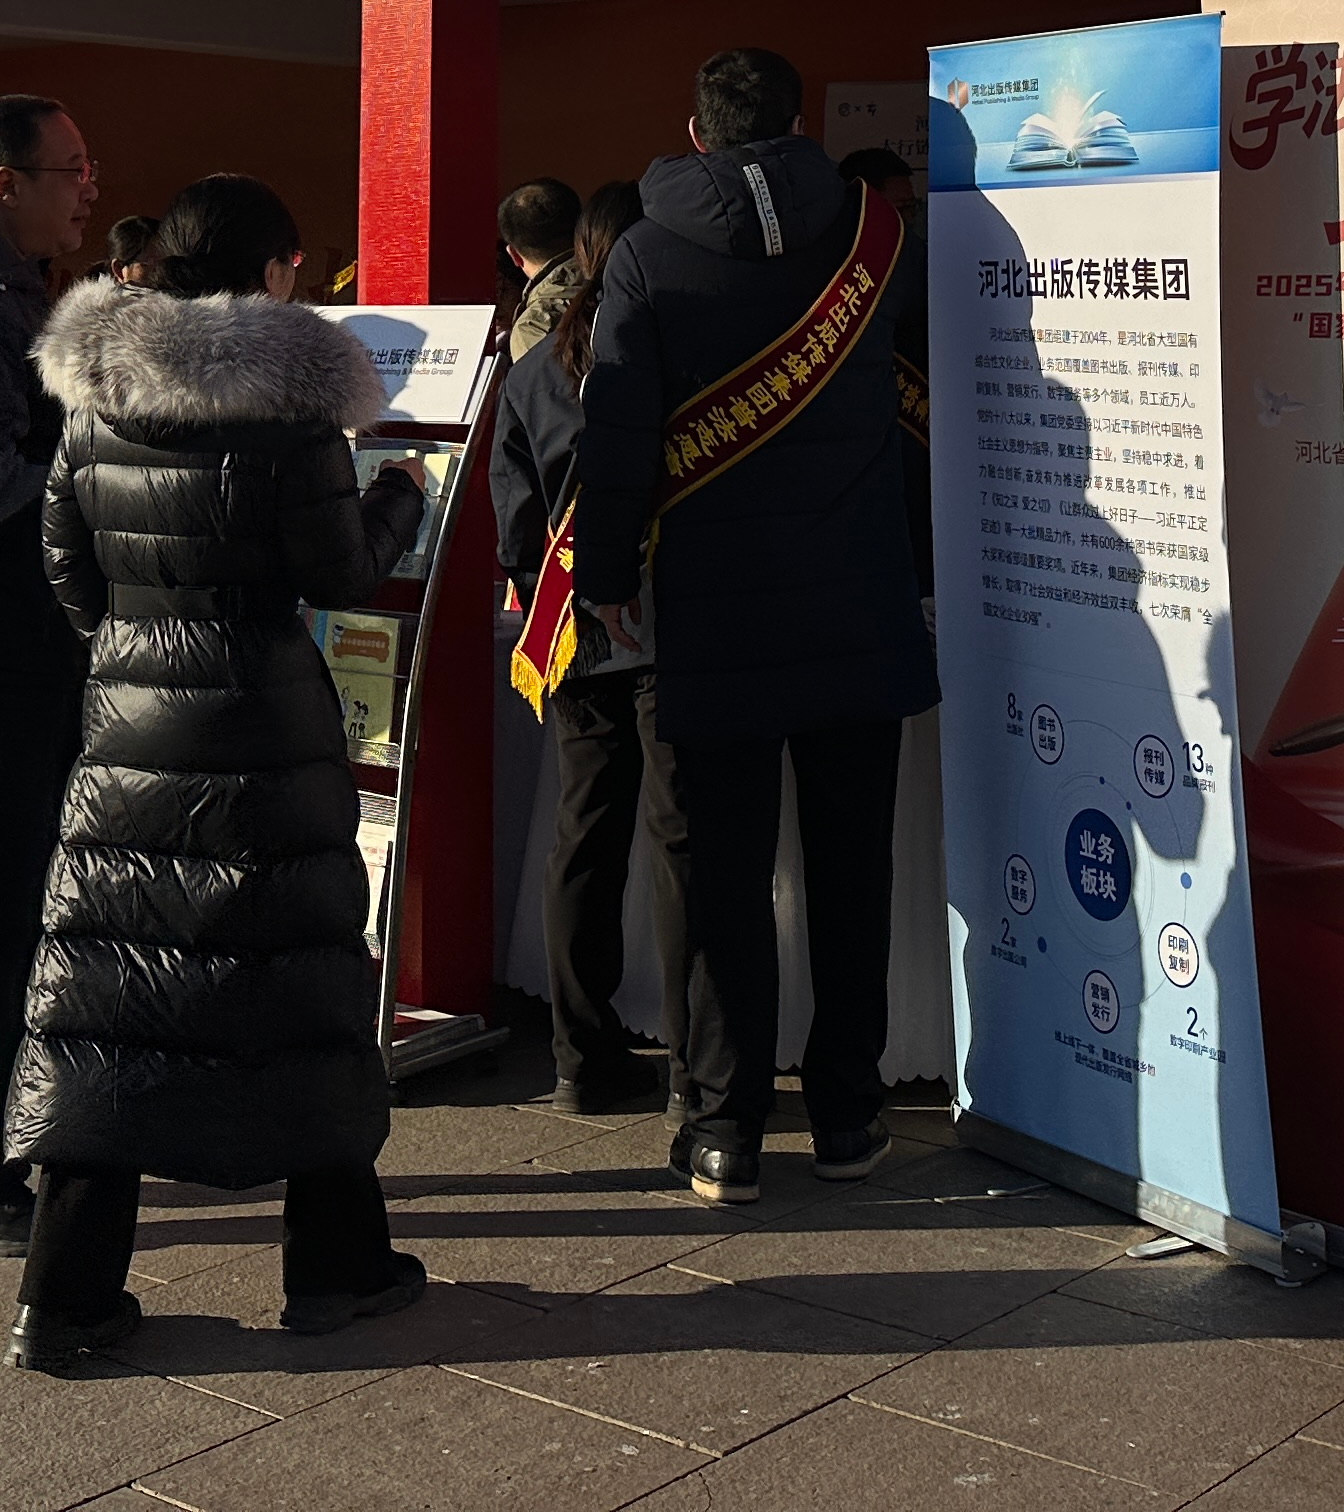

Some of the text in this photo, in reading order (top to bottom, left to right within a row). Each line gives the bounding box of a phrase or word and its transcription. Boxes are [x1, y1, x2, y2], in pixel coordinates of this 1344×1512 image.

[971, 78, 1038, 97] 河北出版传媒集团
[978, 257, 1190, 300] 河北出版传媒集团
[663, 262, 875, 478] 河北出版传媒集团普法志愿者
[1143, 747, 1165, 767] 报刊
[1143, 766, 1166, 787] 传媒
[1079, 829, 1115, 865] 业务
[1080, 864, 1117, 902] 板块
[1168, 934, 1189, 955] 印刷
[1168, 954, 1190, 976] 复制
[1091, 1002, 1111, 1023] 发行
